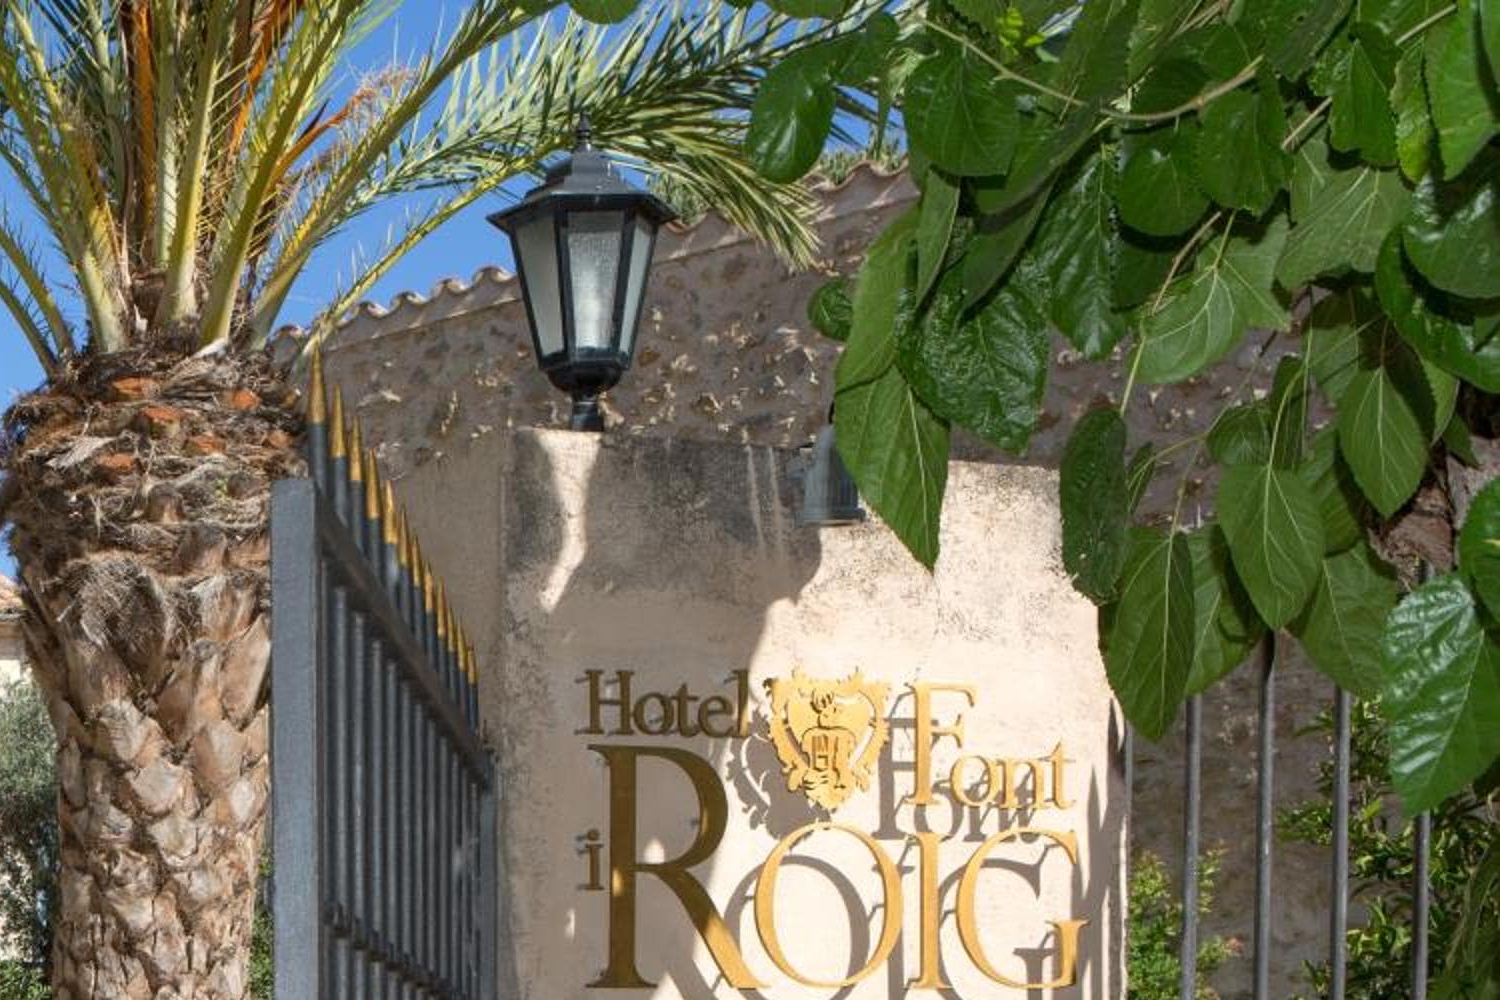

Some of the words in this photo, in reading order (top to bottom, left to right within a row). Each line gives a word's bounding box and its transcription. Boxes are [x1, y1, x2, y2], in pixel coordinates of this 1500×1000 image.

[581, 669, 752, 738] Hotel
[908, 682, 1076, 810] Font
[587, 743, 1089, 990] ROIG
